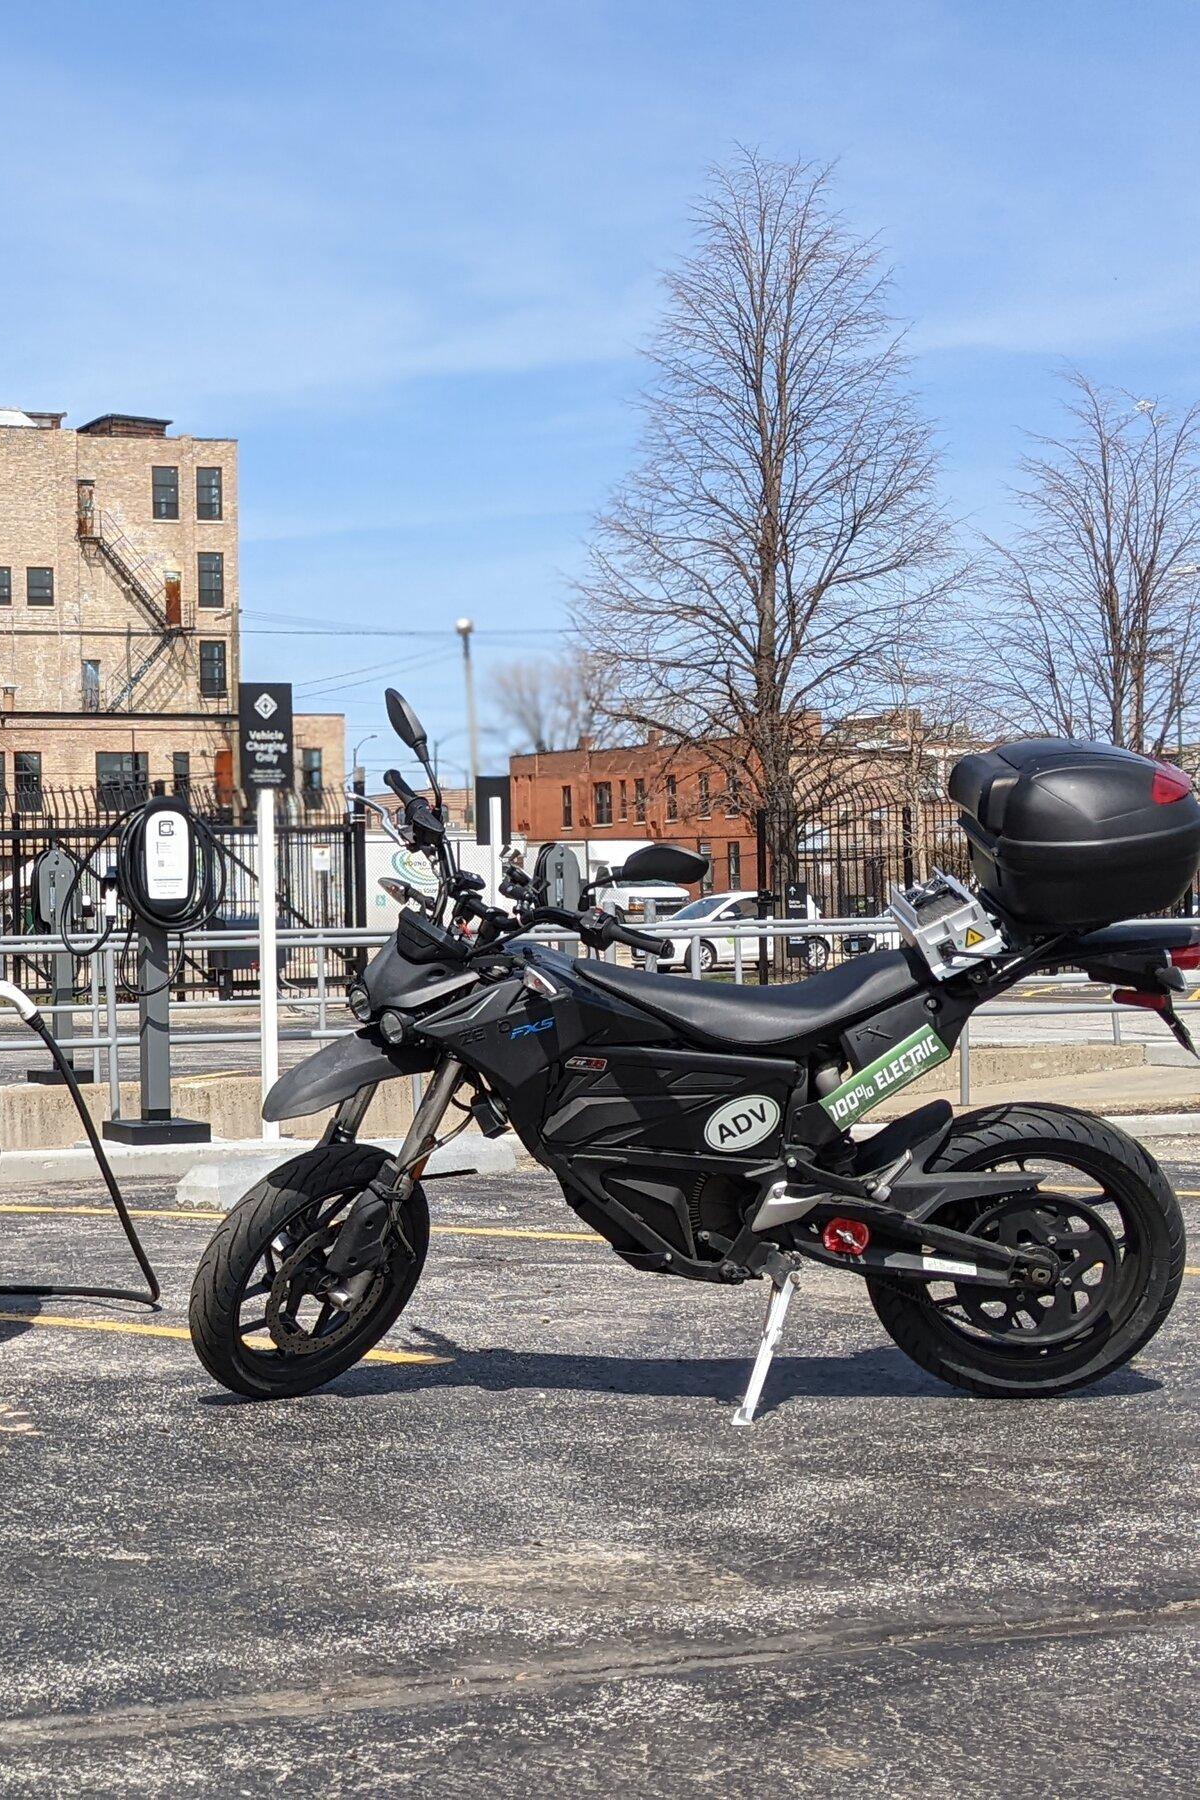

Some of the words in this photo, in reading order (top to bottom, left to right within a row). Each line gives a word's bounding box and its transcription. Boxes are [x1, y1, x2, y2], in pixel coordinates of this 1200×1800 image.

[245, 740, 288, 753] Charging
[248, 730, 284, 740] Vehicle
[828, 1083, 875, 1121] 100%
[873, 1034, 940, 1091] ELECTRIC
[718, 1102, 767, 1144] ADV
